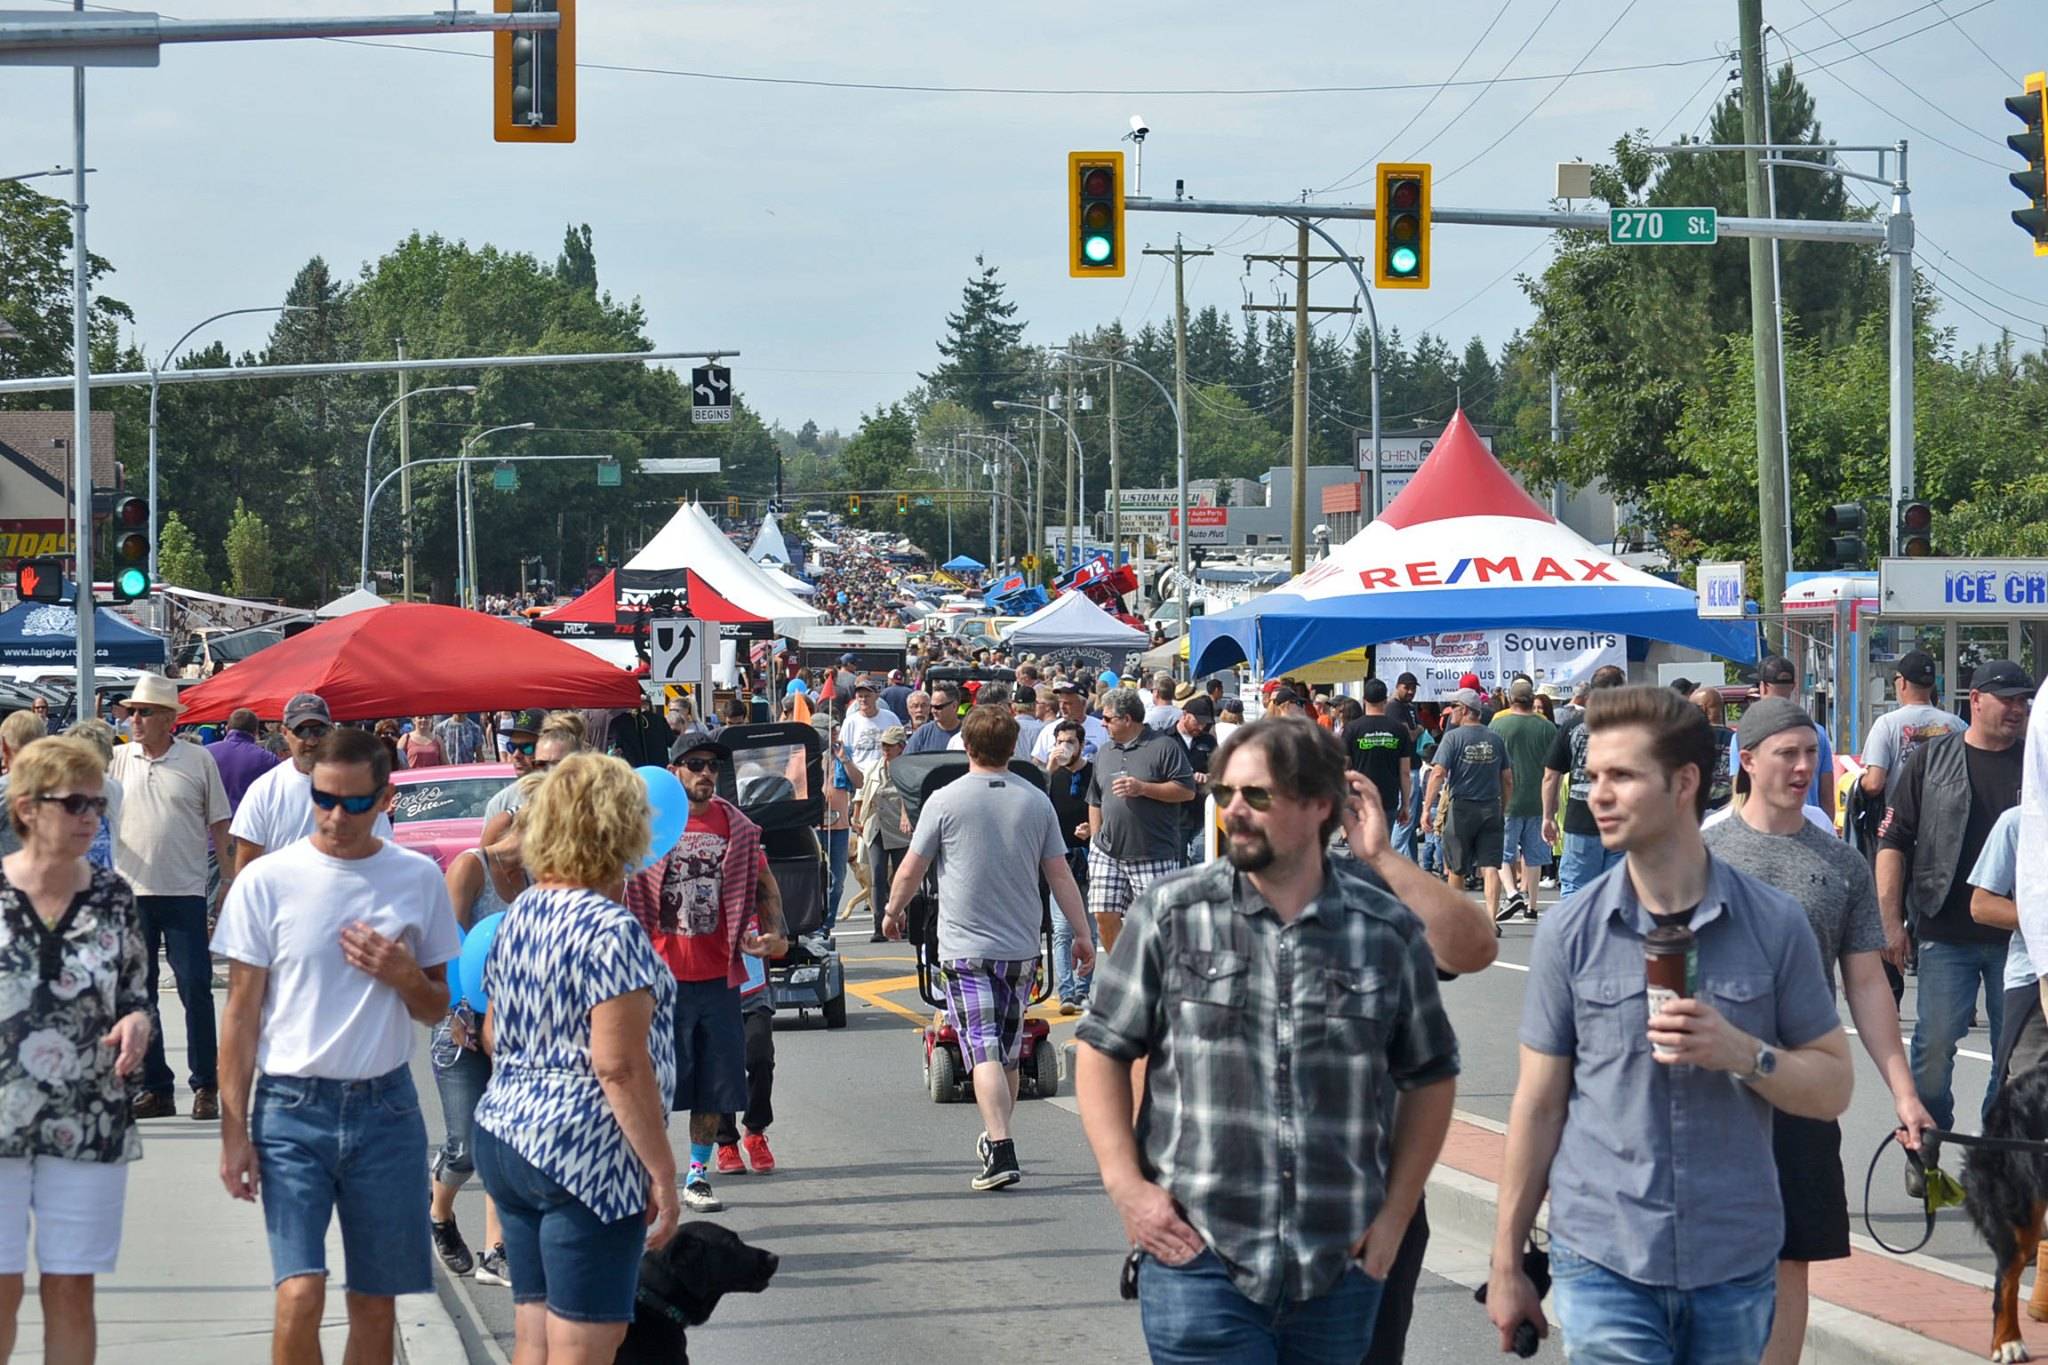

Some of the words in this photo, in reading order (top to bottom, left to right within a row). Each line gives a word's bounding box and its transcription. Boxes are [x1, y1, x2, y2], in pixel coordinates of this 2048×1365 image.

[1617, 212, 1663, 239] 270
[1687, 216, 1710, 234] St.
[695, 409, 730, 420] BEGINS
[1360, 448, 1417, 462] KICHEN
[1121, 493, 1160, 502] USTOM
[1188, 530, 1207, 538] Auto
[1208, 530, 1224, 538] Plus
[1085, 560, 1105, 578] 72
[1359, 557, 1619, 589] RE/MAX
[1945, 570, 1997, 603] ICE
[2004, 570, 2048, 604] CR
[1504, 632, 1617, 652] Souvenirs
[1480, 671, 1495, 680] us
